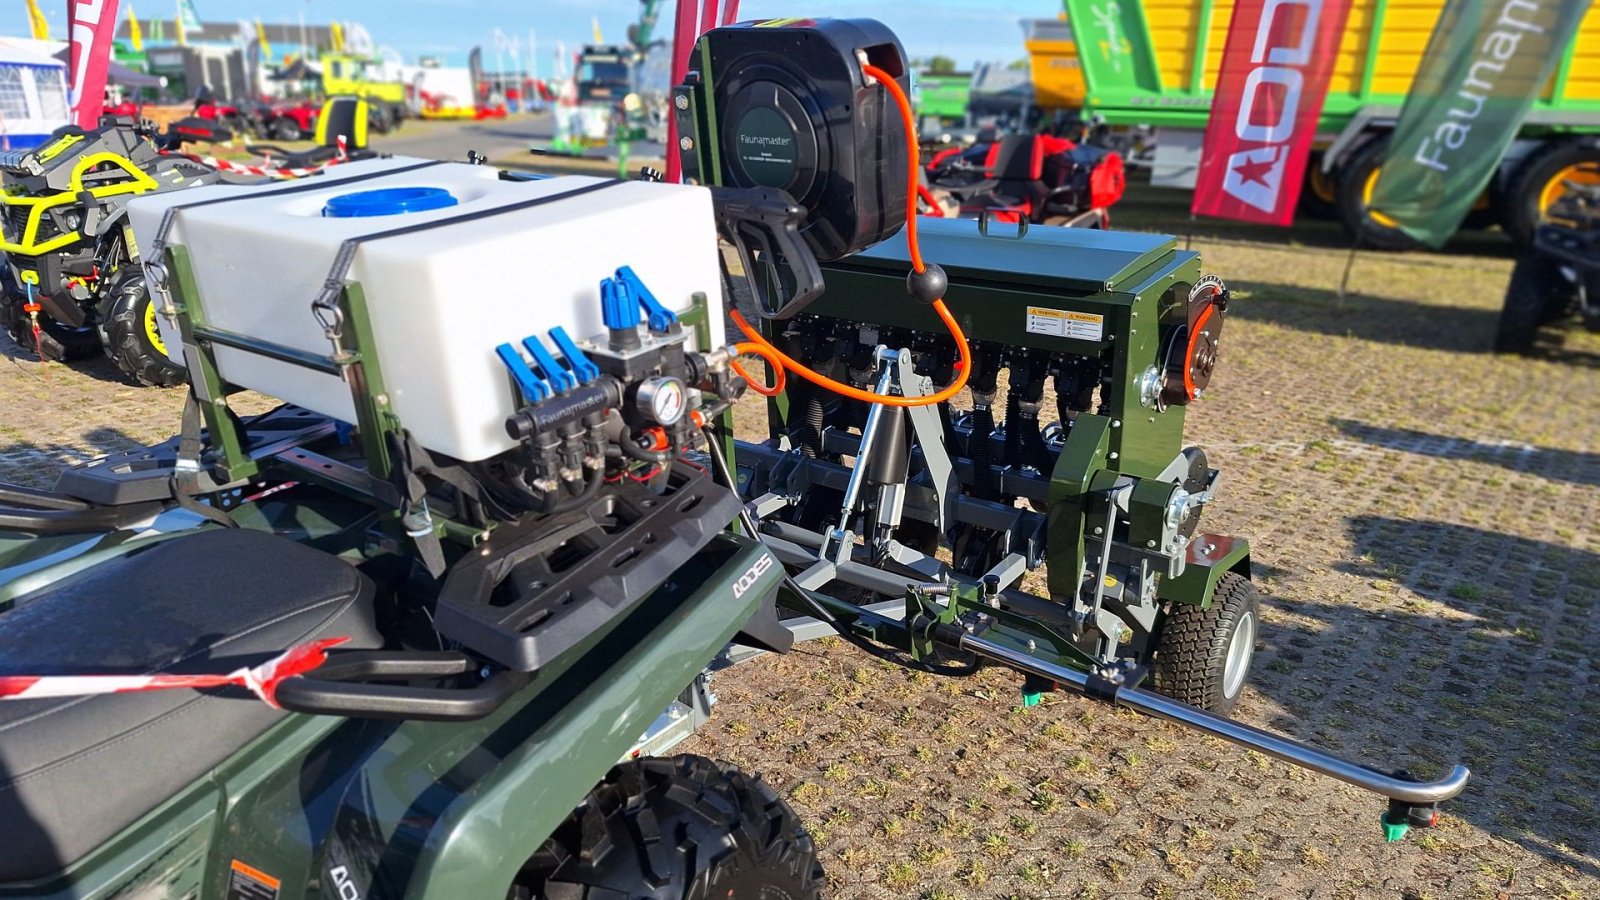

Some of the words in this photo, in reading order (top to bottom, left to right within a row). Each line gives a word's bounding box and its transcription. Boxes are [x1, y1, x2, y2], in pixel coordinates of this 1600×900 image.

[740, 134, 790, 148] Faunamaster
[540, 393, 604, 425] Faunamaster
[732, 553, 773, 599] AODES
